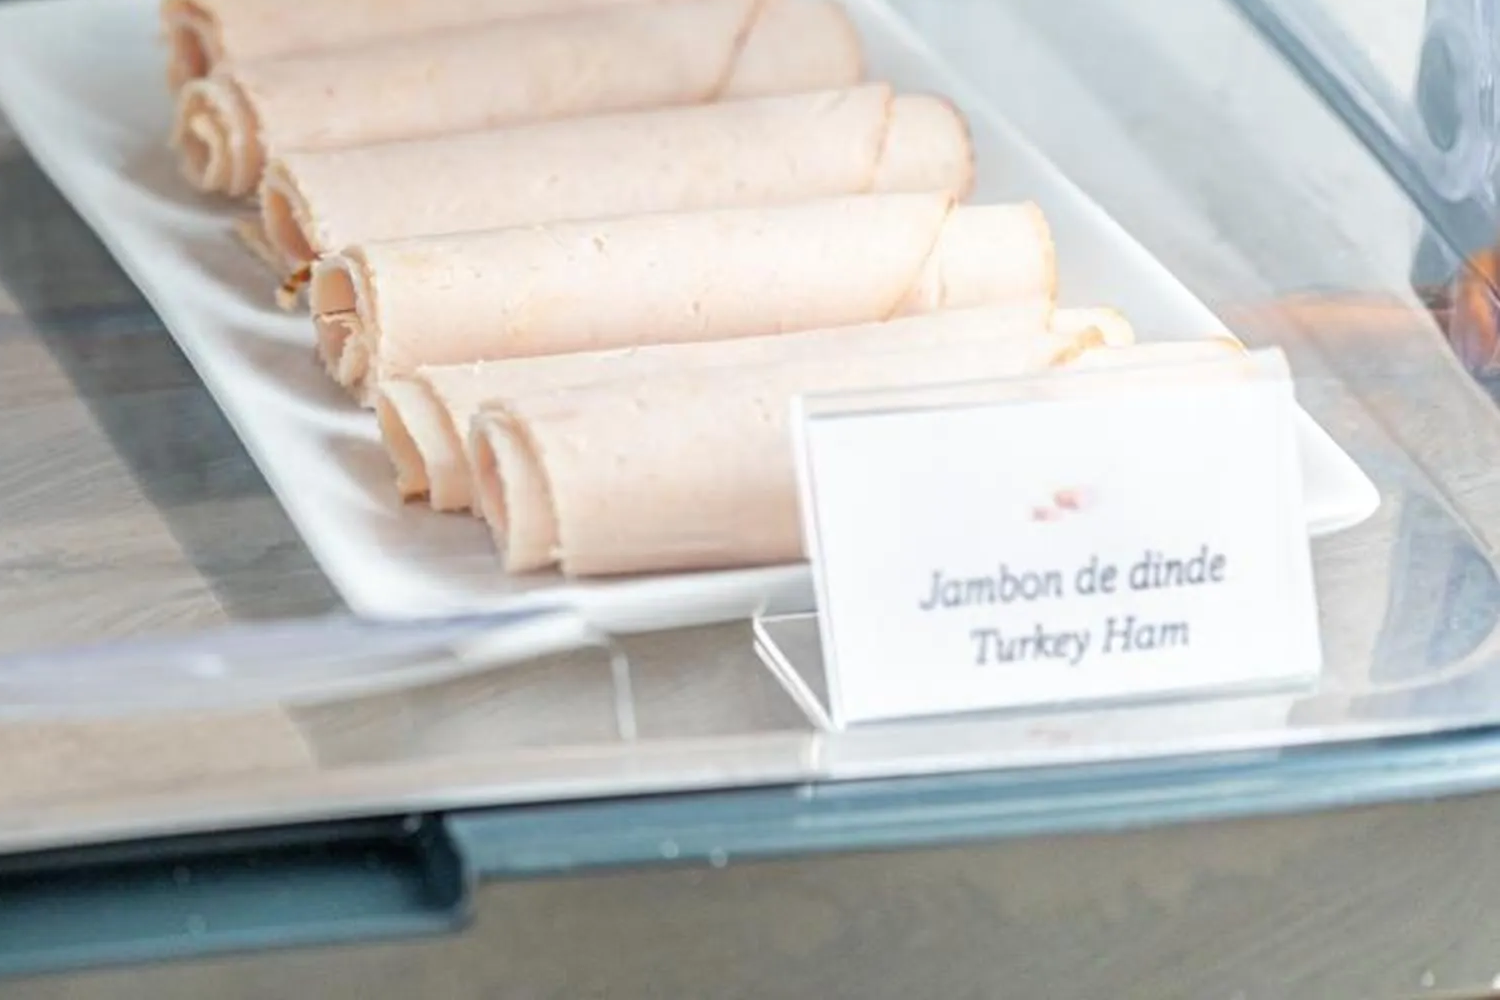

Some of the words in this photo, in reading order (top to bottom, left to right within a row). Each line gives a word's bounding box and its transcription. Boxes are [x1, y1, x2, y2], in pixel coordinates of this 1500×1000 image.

[919, 564, 1063, 611] Jambon
[1075, 555, 1117, 595] de
[1129, 545, 1226, 591] dinde
[970, 624, 1090, 666] Turkey
[1102, 614, 1190, 655] Ham
